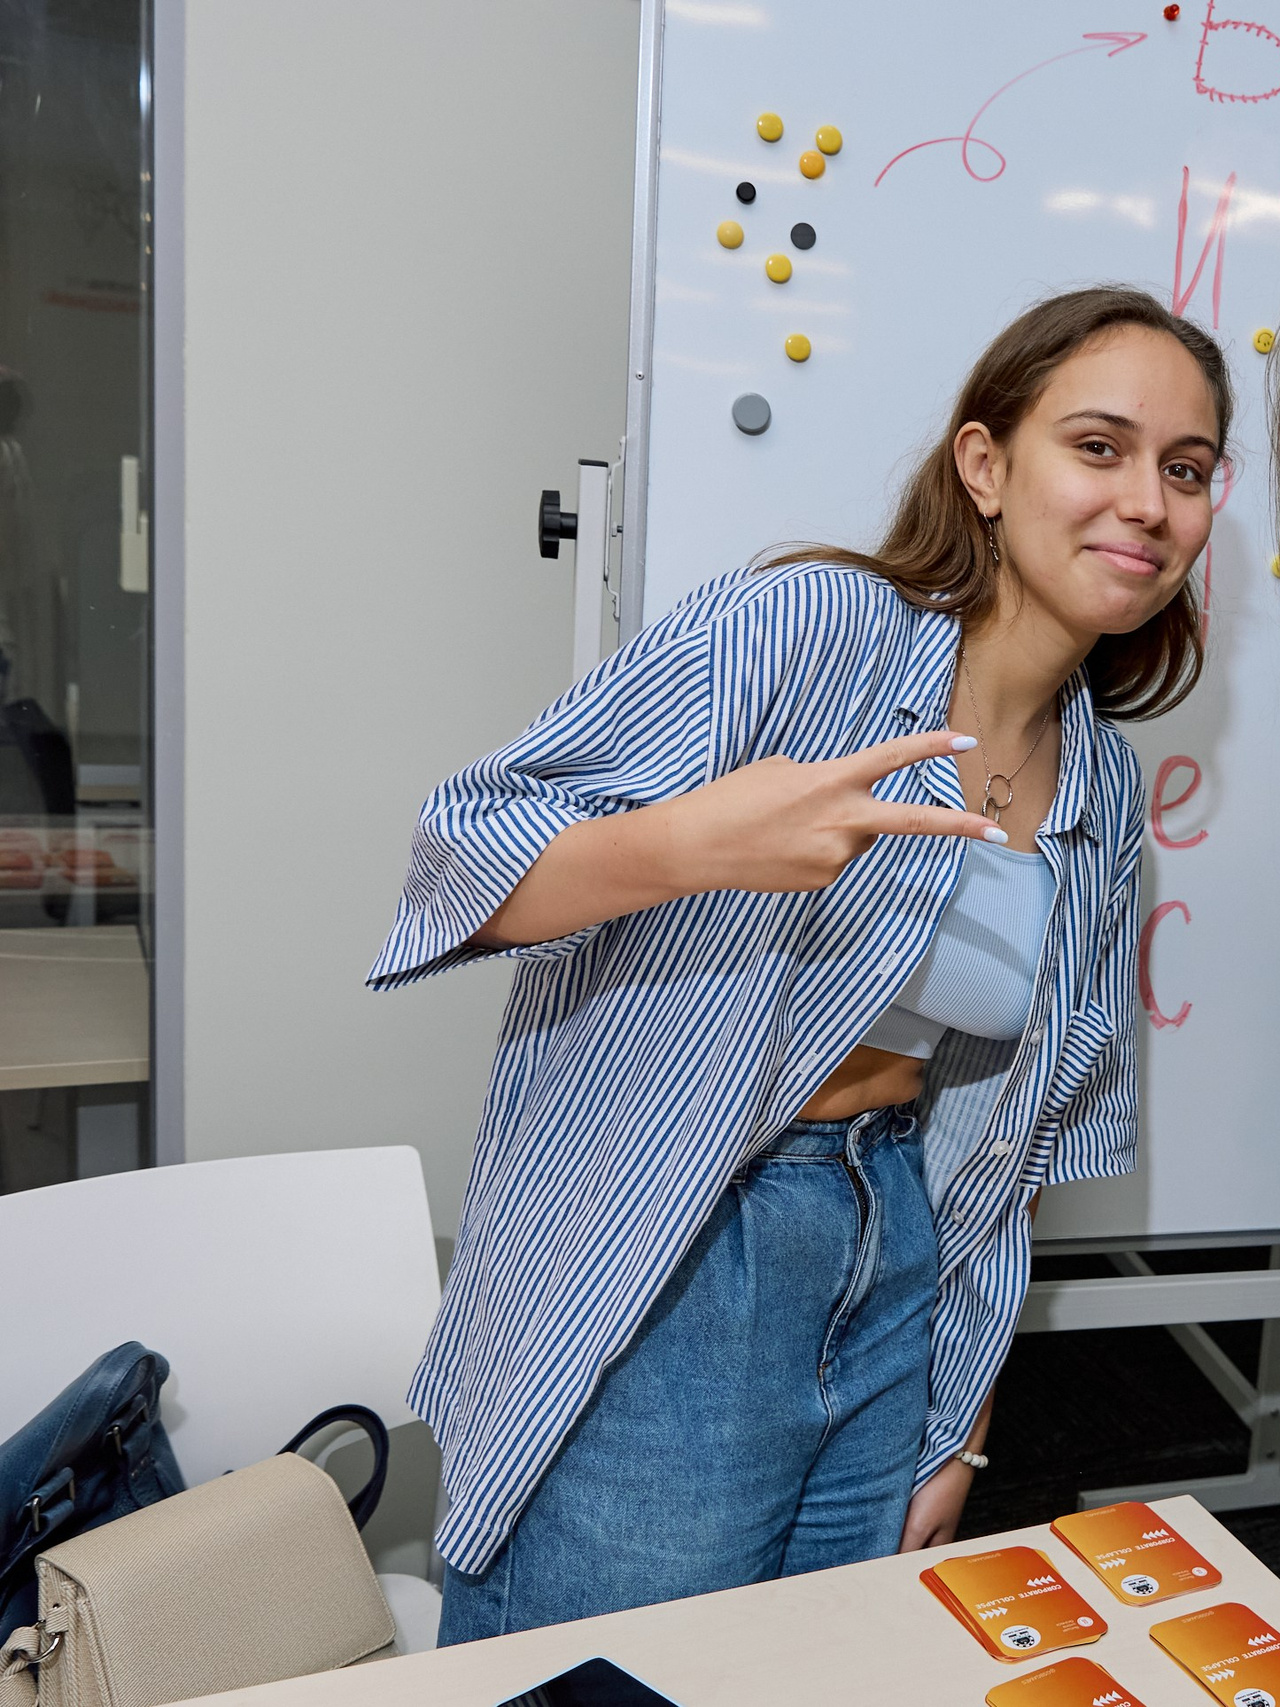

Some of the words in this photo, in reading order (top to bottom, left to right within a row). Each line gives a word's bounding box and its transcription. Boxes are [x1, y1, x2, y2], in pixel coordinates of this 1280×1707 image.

[1134, 1537, 1176, 1551] CORPORATE
[1094, 1547, 1133, 1560] COLLAPSE
[1018, 1584, 1062, 1599] CORPORATE
[974, 1595, 1016, 1610] COLLAPSE
[1201, 1656, 1240, 1672] COLLAPSE
